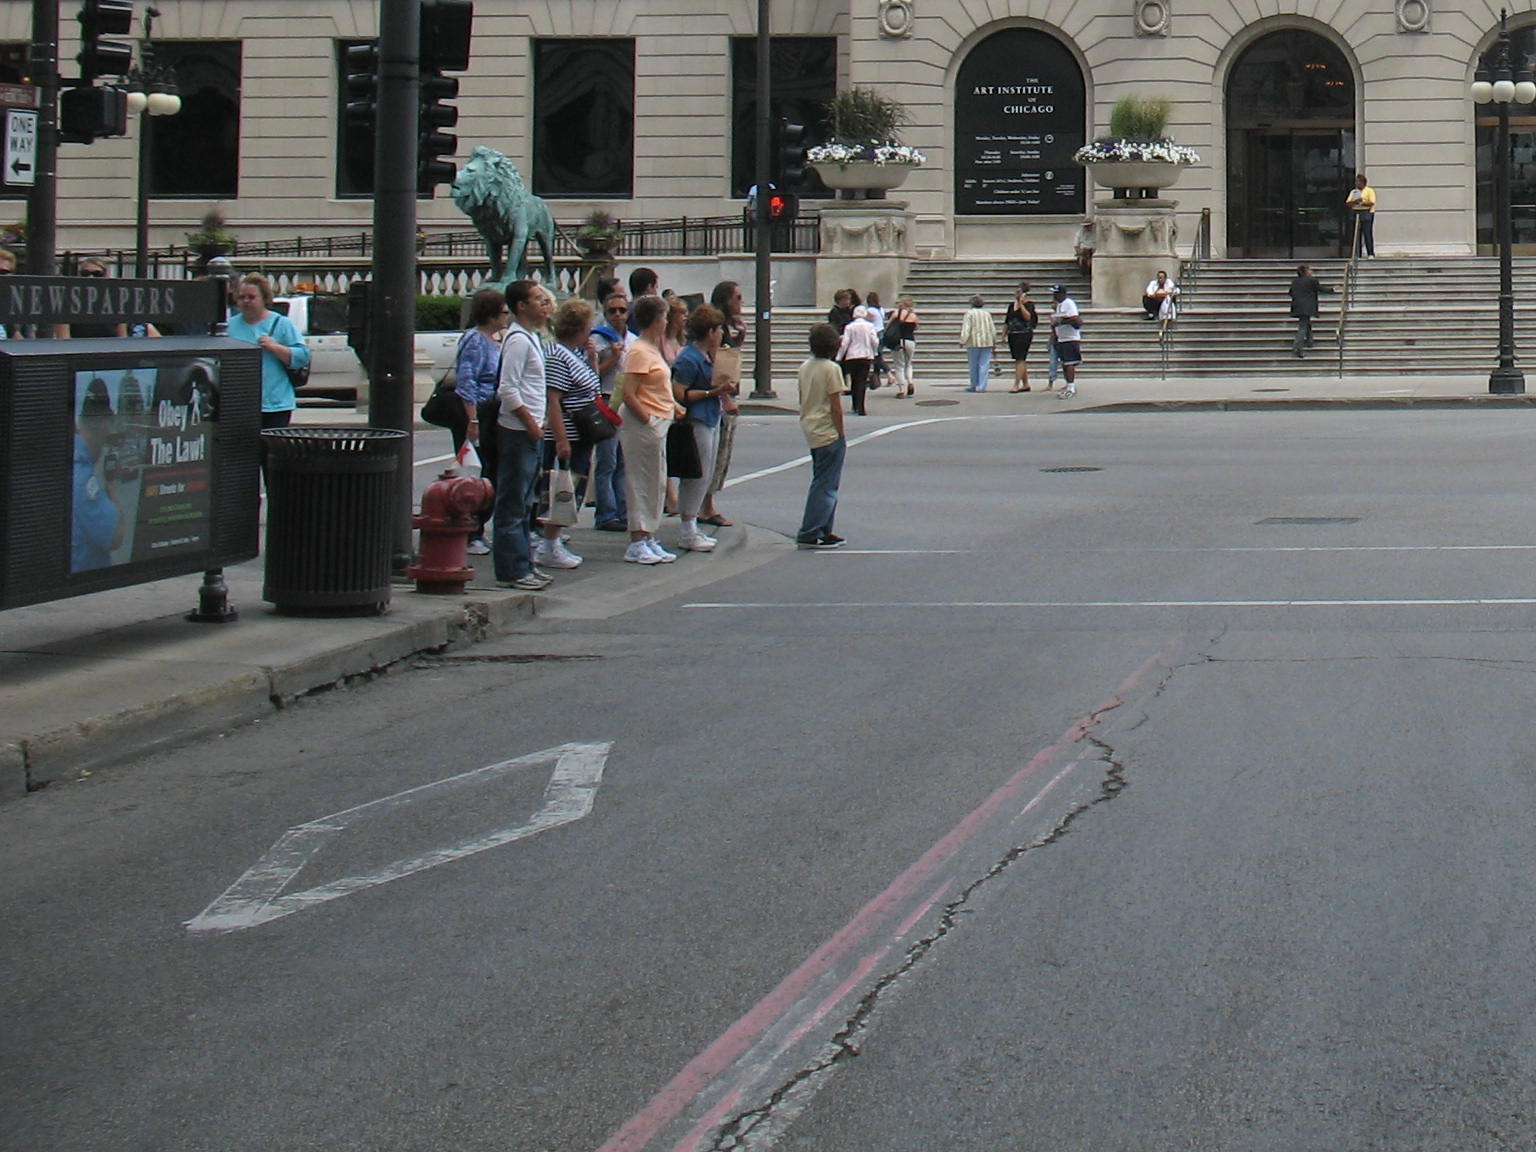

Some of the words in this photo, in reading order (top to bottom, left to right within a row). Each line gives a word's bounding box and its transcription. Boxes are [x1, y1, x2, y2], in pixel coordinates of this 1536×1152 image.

[973, 86, 995, 95] ART
[997, 86, 1054, 94] INSTITUTE
[1003, 105, 1054, 114] CHICAGO
[11, 116, 34, 133] ONE
[10, 137, 33, 152] WAY
[8, 284, 176, 316] NEWSPAPERS
[158, 399, 189, 432] Obey
[150, 436, 173, 466] The
[175, 433, 206, 463] Law!
